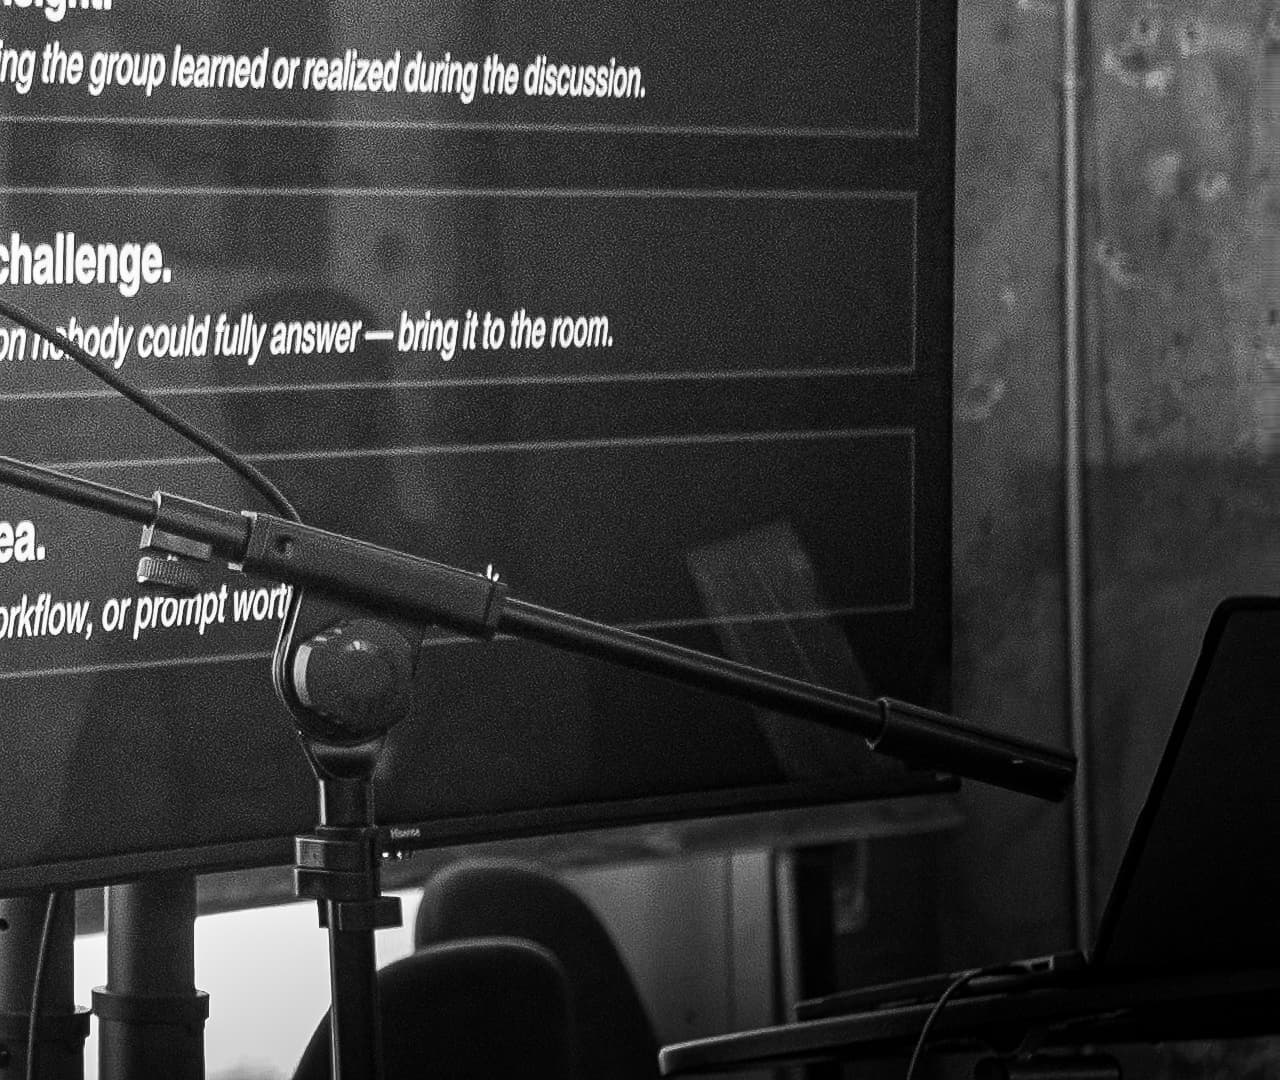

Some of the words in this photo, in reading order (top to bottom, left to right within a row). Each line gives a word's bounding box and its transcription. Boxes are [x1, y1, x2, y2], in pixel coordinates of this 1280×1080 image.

[41, 40, 84, 85] the
[88, 51, 166, 97] group
[170, 44, 269, 89] learned
[271, 56, 301, 90] or
[302, 49, 401, 92] realized
[403, 51, 479, 104] during
[482, 53, 520, 95] the
[523, 55, 646, 98] discussion.
[137, 314, 211, 358] could
[214, 313, 267, 366] fully
[269, 320, 363, 355] answer
[397, 310, 459, 361] bring
[462, 309, 479, 350] it
[482, 311, 506, 350] to
[509, 308, 547, 349] the
[550, 315, 613, 349] room.
[101, 597, 132, 632] or
[132, 584, 228, 640] prompt
[233, 583, 293, 622] wort
